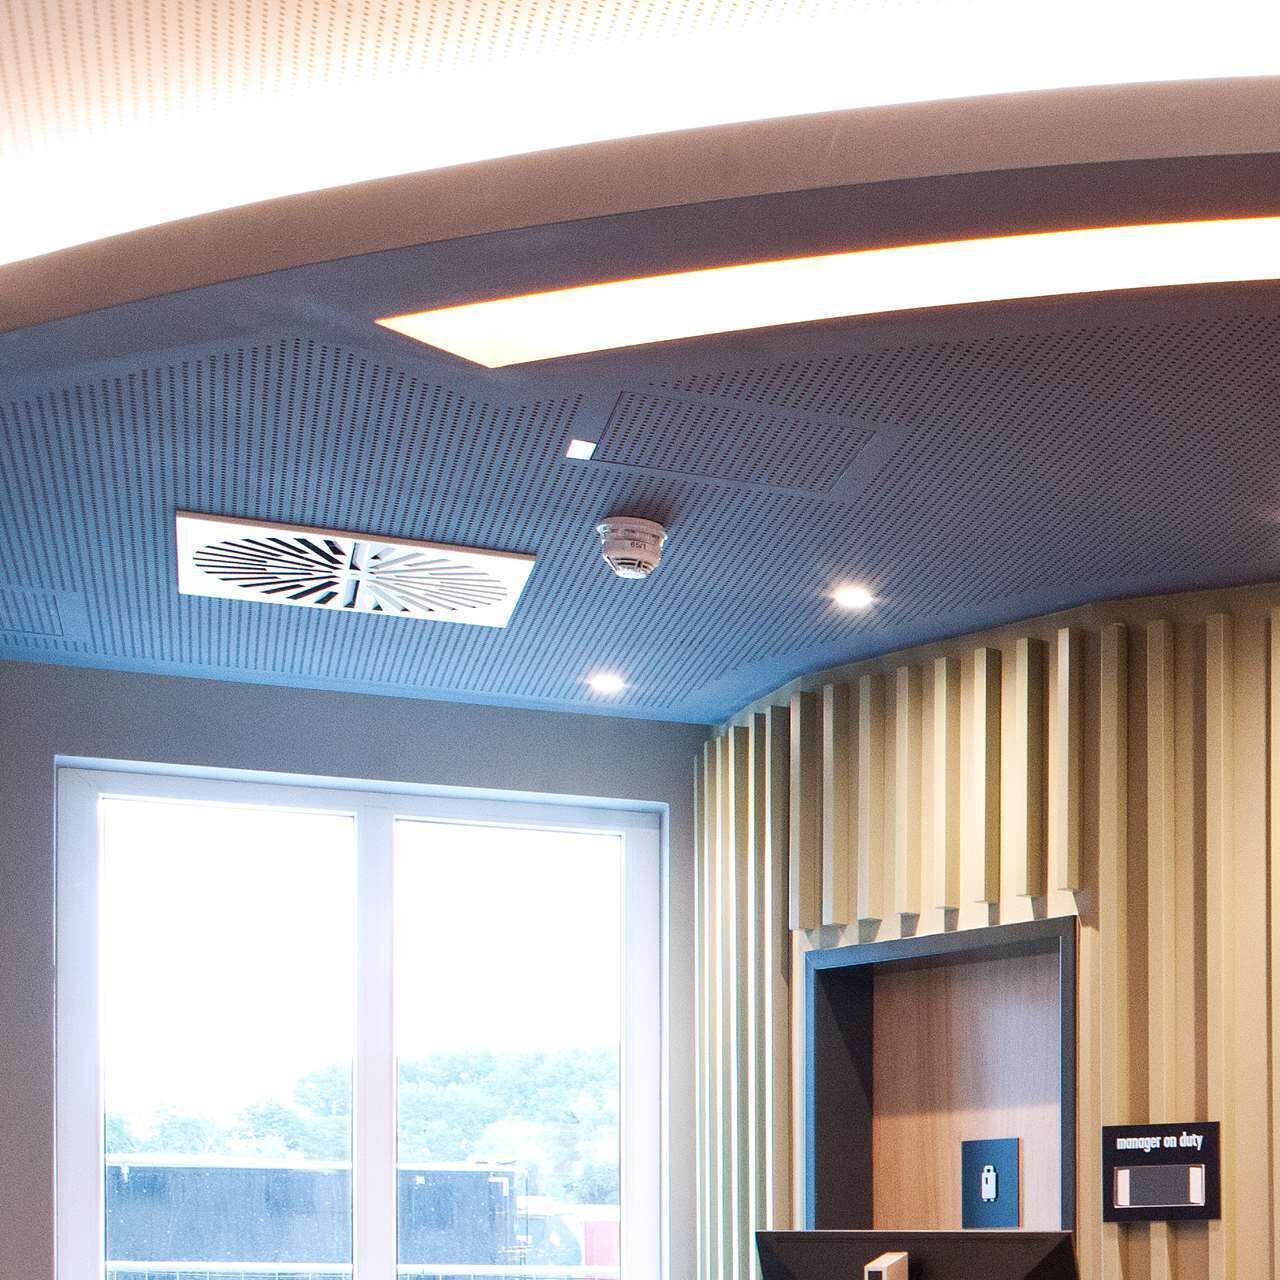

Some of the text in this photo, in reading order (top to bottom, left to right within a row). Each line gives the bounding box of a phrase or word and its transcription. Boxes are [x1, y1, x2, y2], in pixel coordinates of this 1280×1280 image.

[1117, 1131, 1204, 1153] manager on duty
